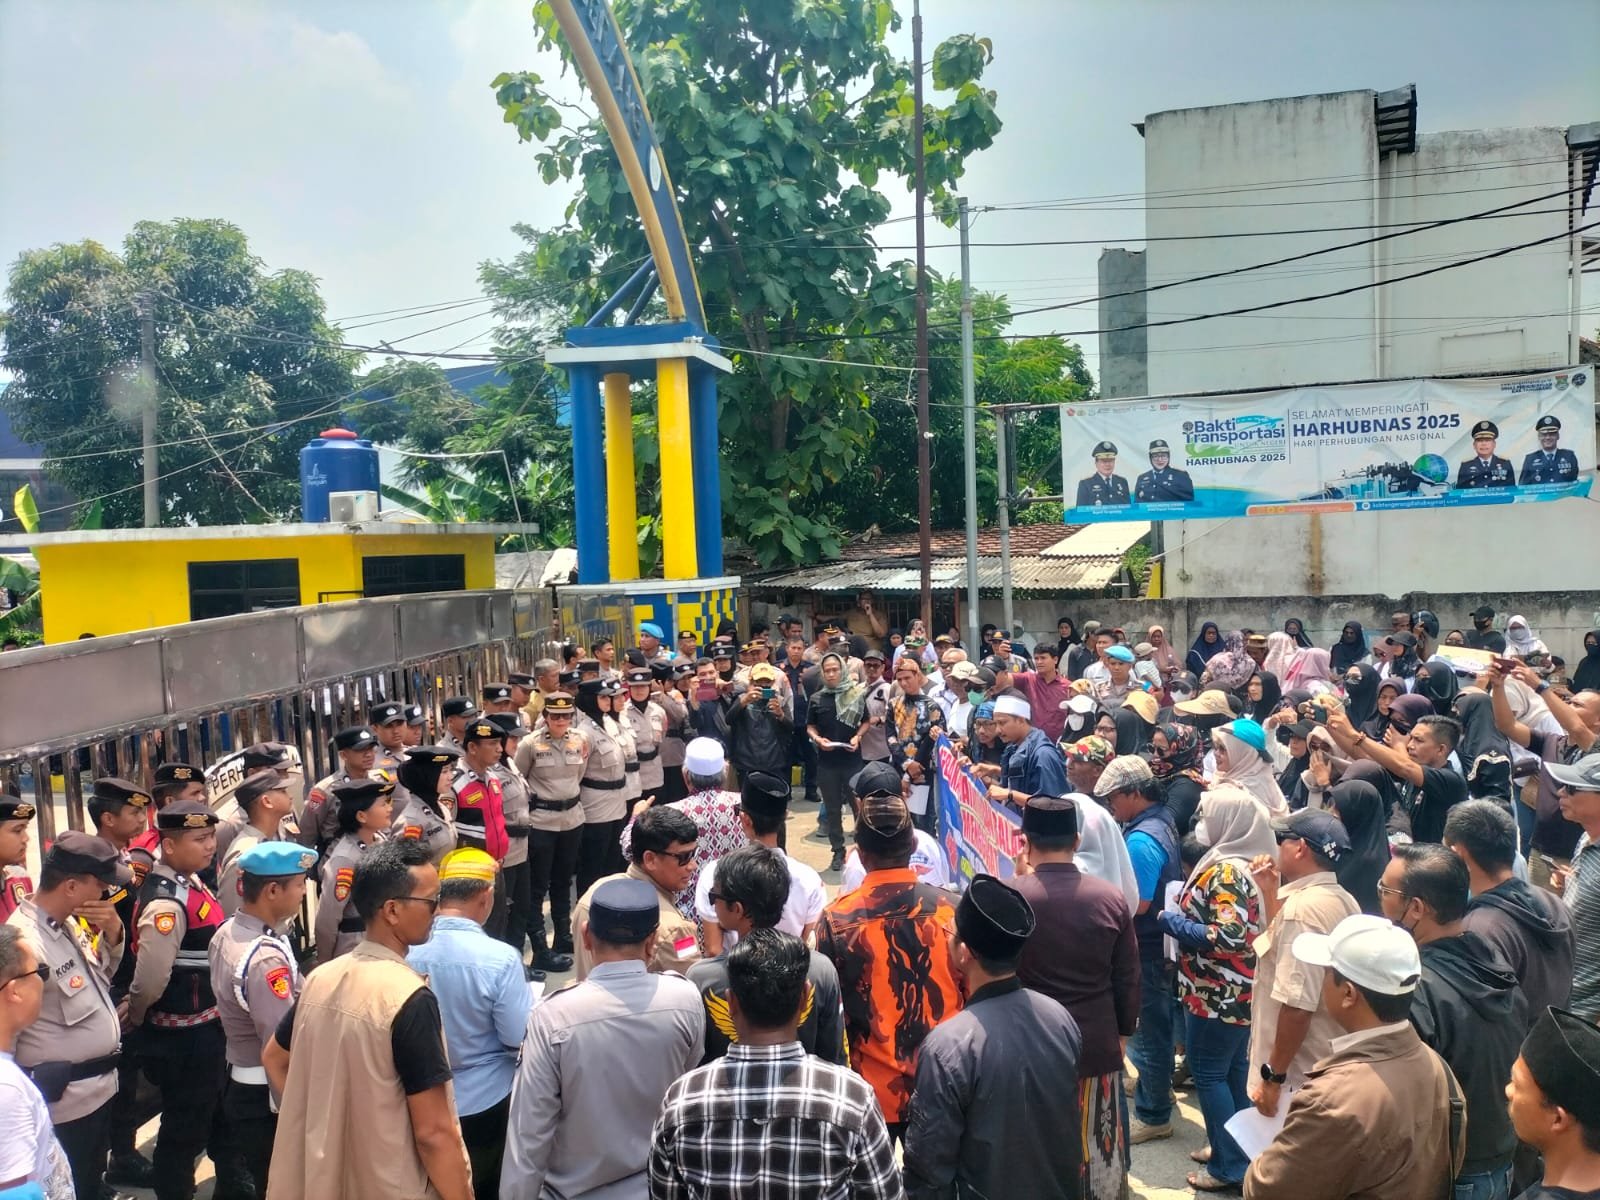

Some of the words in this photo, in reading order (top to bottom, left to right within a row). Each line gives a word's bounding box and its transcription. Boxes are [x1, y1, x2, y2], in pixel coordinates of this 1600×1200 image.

[1292, 408, 1342, 420] SELAMAT
[1344, 402, 1429, 418] MEMPERINGATI
[1183, 423, 1286, 444] Transportasi
[1194, 417, 1236, 433] Bakti
[1292, 416, 1412, 437] HARHUBNAS
[1416, 413, 1461, 430] 2025
[1294, 439, 1316, 449] HARI
[1319, 434, 1392, 447] PERHUBUNGAN
[1396, 431, 1446, 442] NASIONAL
[1185, 454, 1257, 466] HARHUBNAS
[1260, 453, 1286, 462] 2025
